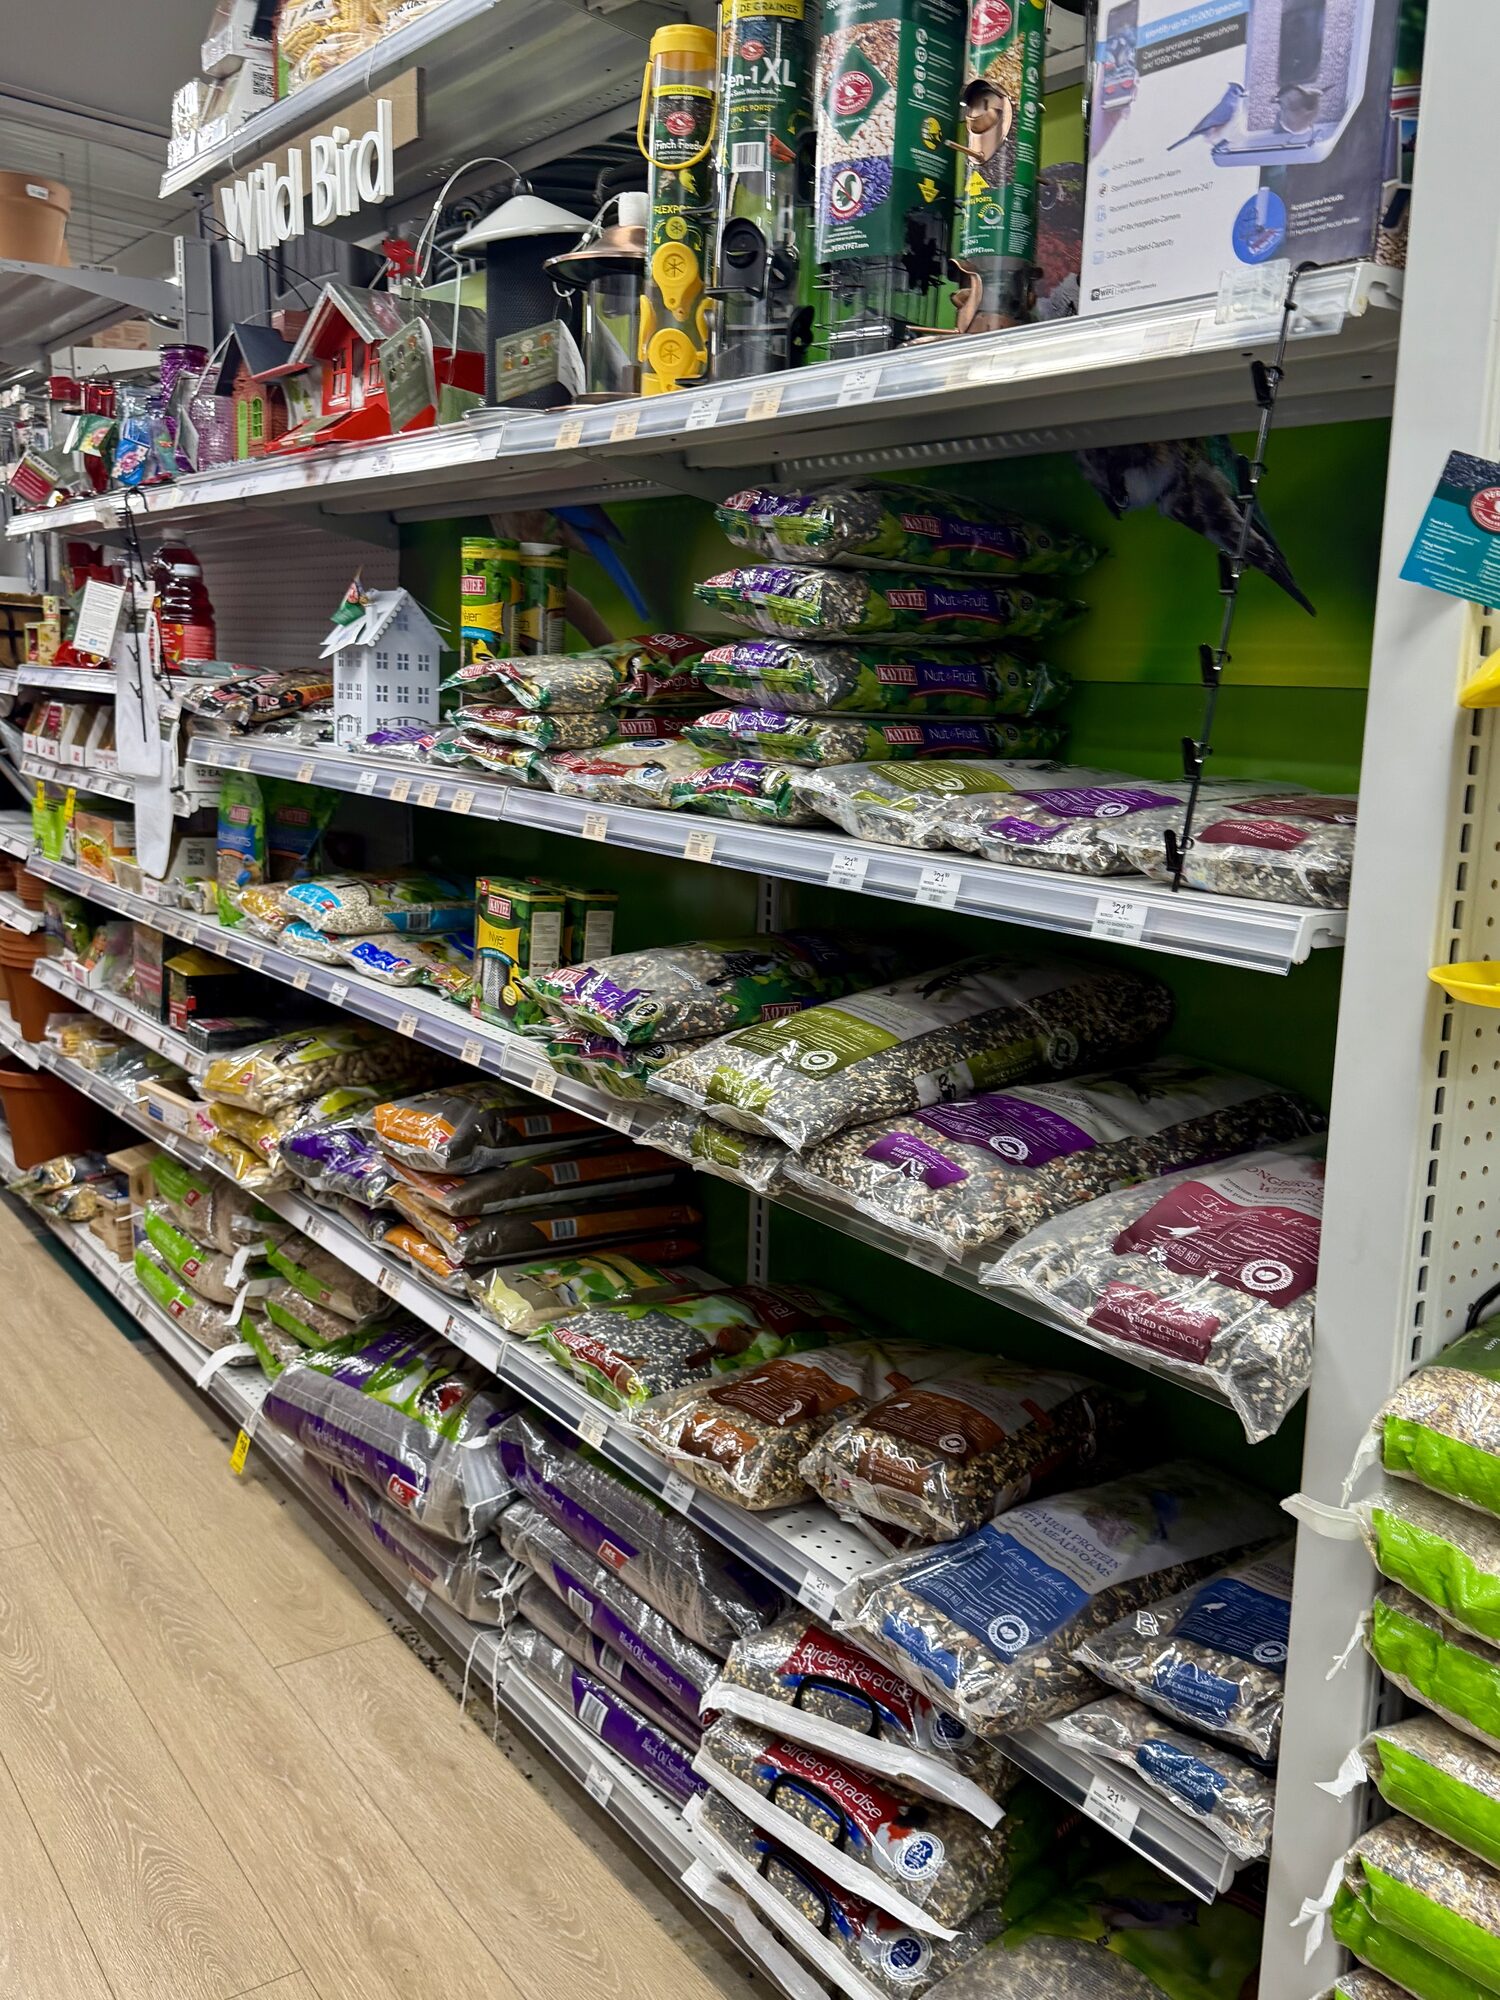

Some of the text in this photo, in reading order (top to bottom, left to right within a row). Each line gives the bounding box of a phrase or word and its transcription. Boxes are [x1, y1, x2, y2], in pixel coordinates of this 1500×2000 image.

[753, 1, 799, 14] GRAINES
[761, 57, 797, 88] XL
[655, 139, 704, 152] Finch Feede
[220, 98, 394, 263] Wild Bird
[903, 514, 941, 535] KAYTEE
[949, 522, 971, 537] Nut
[978, 526, 1005, 543] Fruit
[889, 591, 926, 607] KAYTEE
[933, 592, 957, 607] Nut
[962, 593, 990, 608] Fruit
[878, 667, 917, 684] KAYTEE
[923, 668, 945, 683] Nut
[952, 668, 978, 684] Fruit
[620, 722, 655, 735] KAYTEE
[885, 728, 923, 743] KAYTEE
[928, 727, 951, 741] Nut
[956, 727, 981, 740] Fruit
[489, 898, 511, 915] KAYTEE
[488, 930, 506, 947] Nyjer
[1106, 1302, 1200, 1348] SONGBIRD CRUNCH
[1041, 1527, 1115, 1579] MEALWORMS
[1073, 1530, 1123, 1570] PROTEIN
[618, 1630, 634, 1650] Black
[641, 1651, 669, 1682] Sunflower
[667, 1676, 683, 1696] Seed
[801, 1642, 915, 1701] Birders' Paradise
[640, 1736, 658, 1758] Black
[656, 1749, 670, 1767] Oil
[667, 1758, 697, 1793] Sunflower
[780, 1742, 883, 1820] Birders' Paradise
[900, 1940, 919, 1959] 2X
